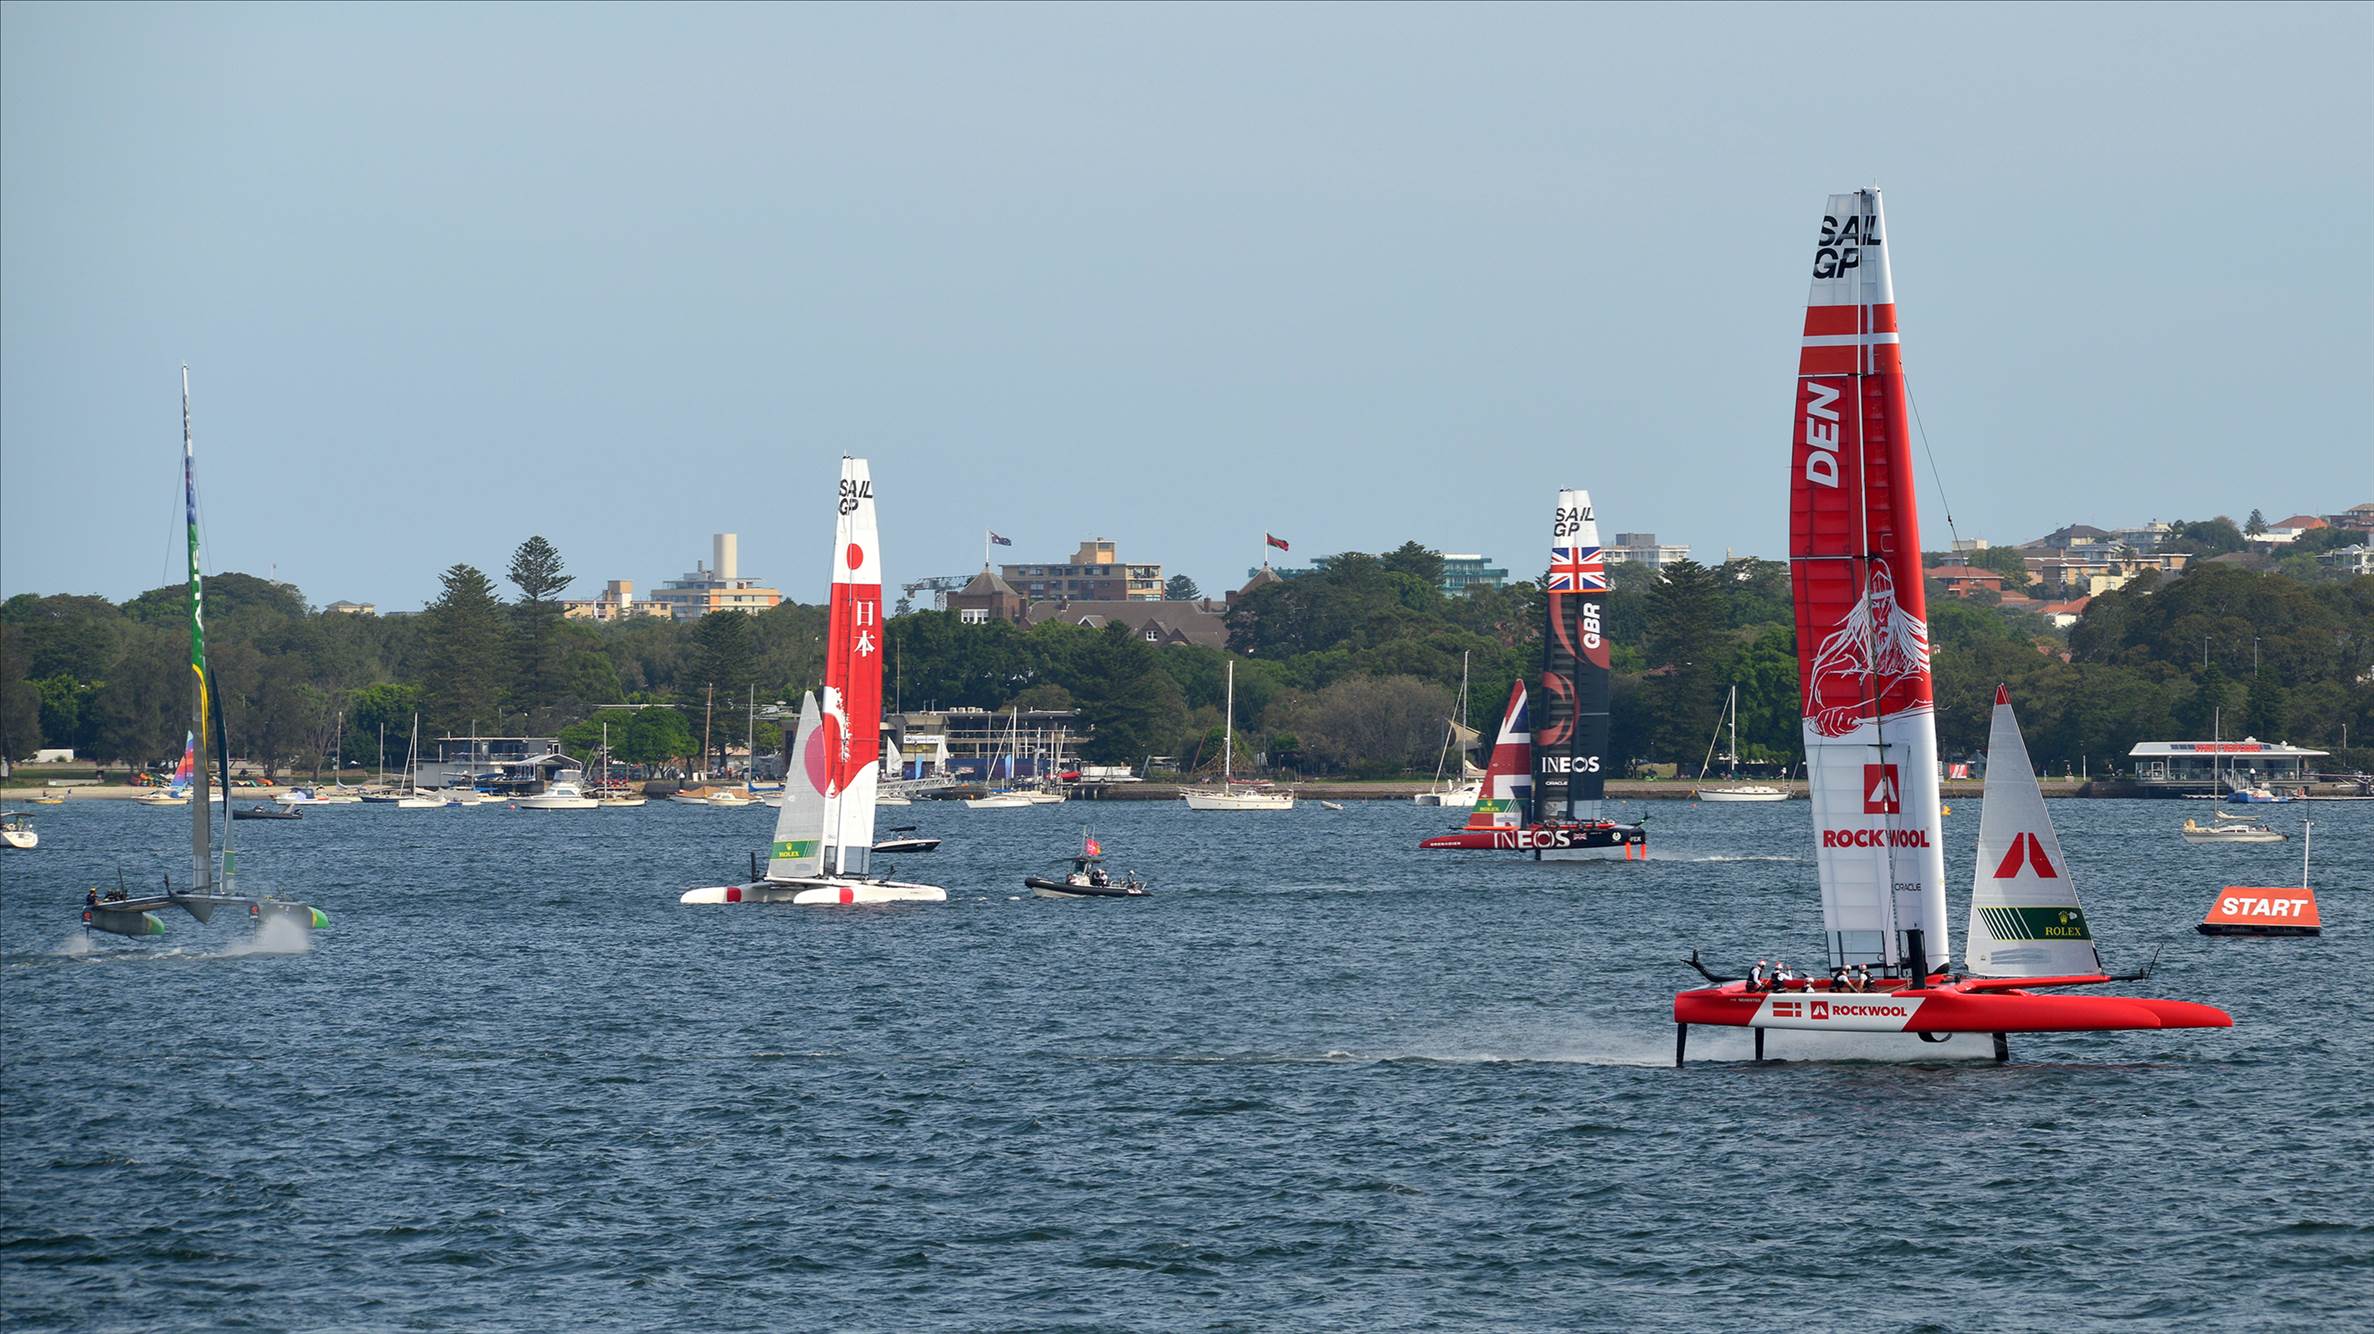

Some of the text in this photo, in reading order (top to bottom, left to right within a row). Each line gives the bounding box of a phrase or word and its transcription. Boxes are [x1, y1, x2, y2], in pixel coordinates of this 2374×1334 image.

[1818, 215, 1882, 246] SAIL
[1812, 247, 1863, 279] GP
[1806, 381, 1840, 489] DEN
[839, 479, 874, 498] SAIL
[838, 498, 859, 516] GP
[1555, 507, 1595, 522] SAIL
[1554, 522, 1580, 537] GP
[854, 600, 875, 658] 日本
[1583, 602, 1601, 649] GBR
[1542, 756, 1600, 773] INEOS
[1494, 830, 1571, 849] INEOS
[1823, 829, 1930, 848] ROCKWOOL
[2221, 897, 2309, 917] START
[2045, 926, 2081, 936] ROLEX
[1832, 1005, 1908, 1017] ROCKWOOL
